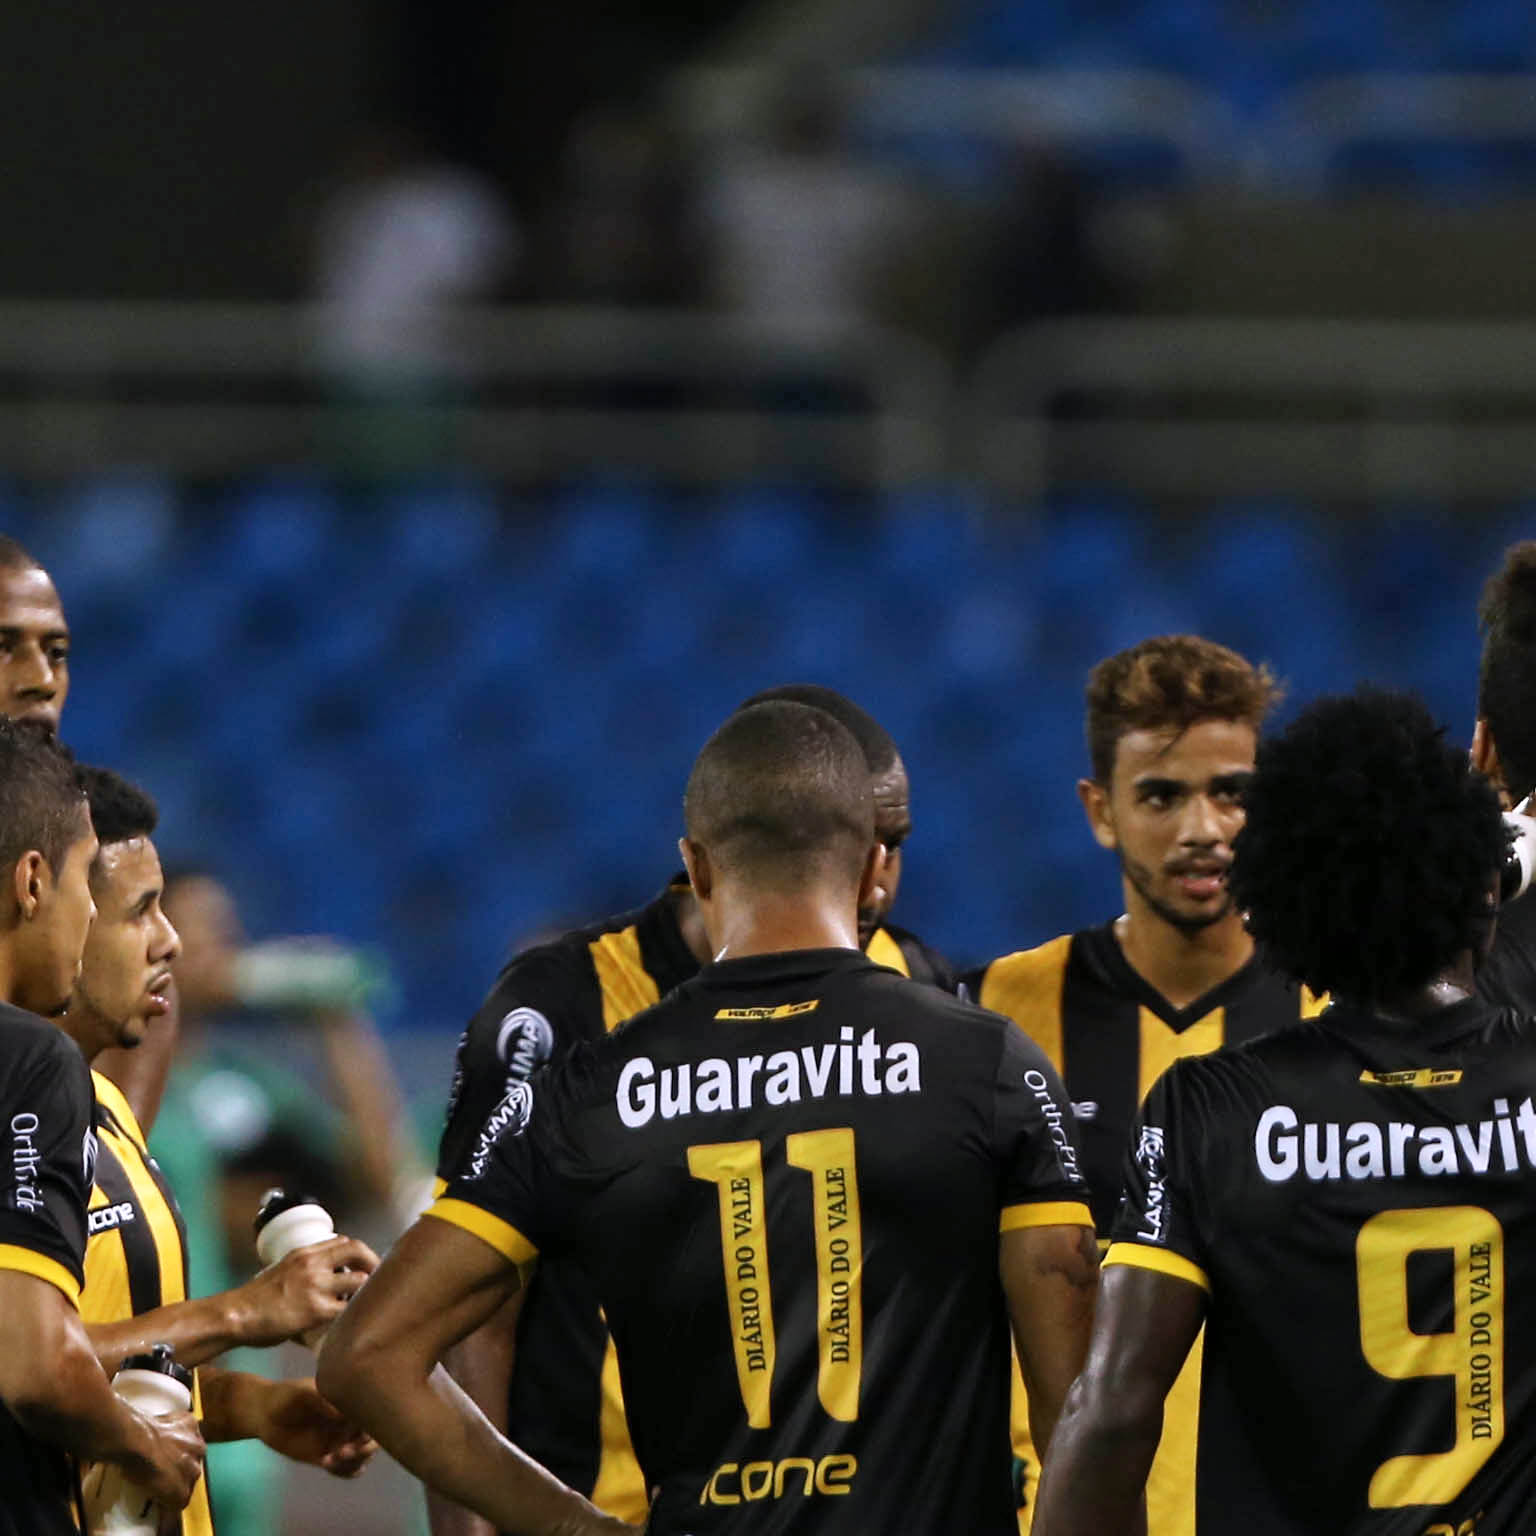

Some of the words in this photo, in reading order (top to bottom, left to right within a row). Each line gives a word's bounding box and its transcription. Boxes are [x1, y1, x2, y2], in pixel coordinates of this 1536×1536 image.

[616, 1026, 921, 1128] Guaravita
[731, 1176, 752, 1241] VALE
[826, 1167, 848, 1232] VALE
[687, 1127, 862, 1430] 11
[735, 1245, 756, 1280] DO
[829, 1238, 850, 1273] DO
[1469, 1242, 1491, 1305] VALE
[740, 1287, 767, 1372] DIÁRIO
[827, 1280, 850, 1364] DIÁRIO
[1470, 1311, 1492, 1348] DO
[1356, 1205, 1504, 1508] 9
[1466, 1353, 1492, 1441] DIÁRIO
[699, 1453, 857, 1506] icone
